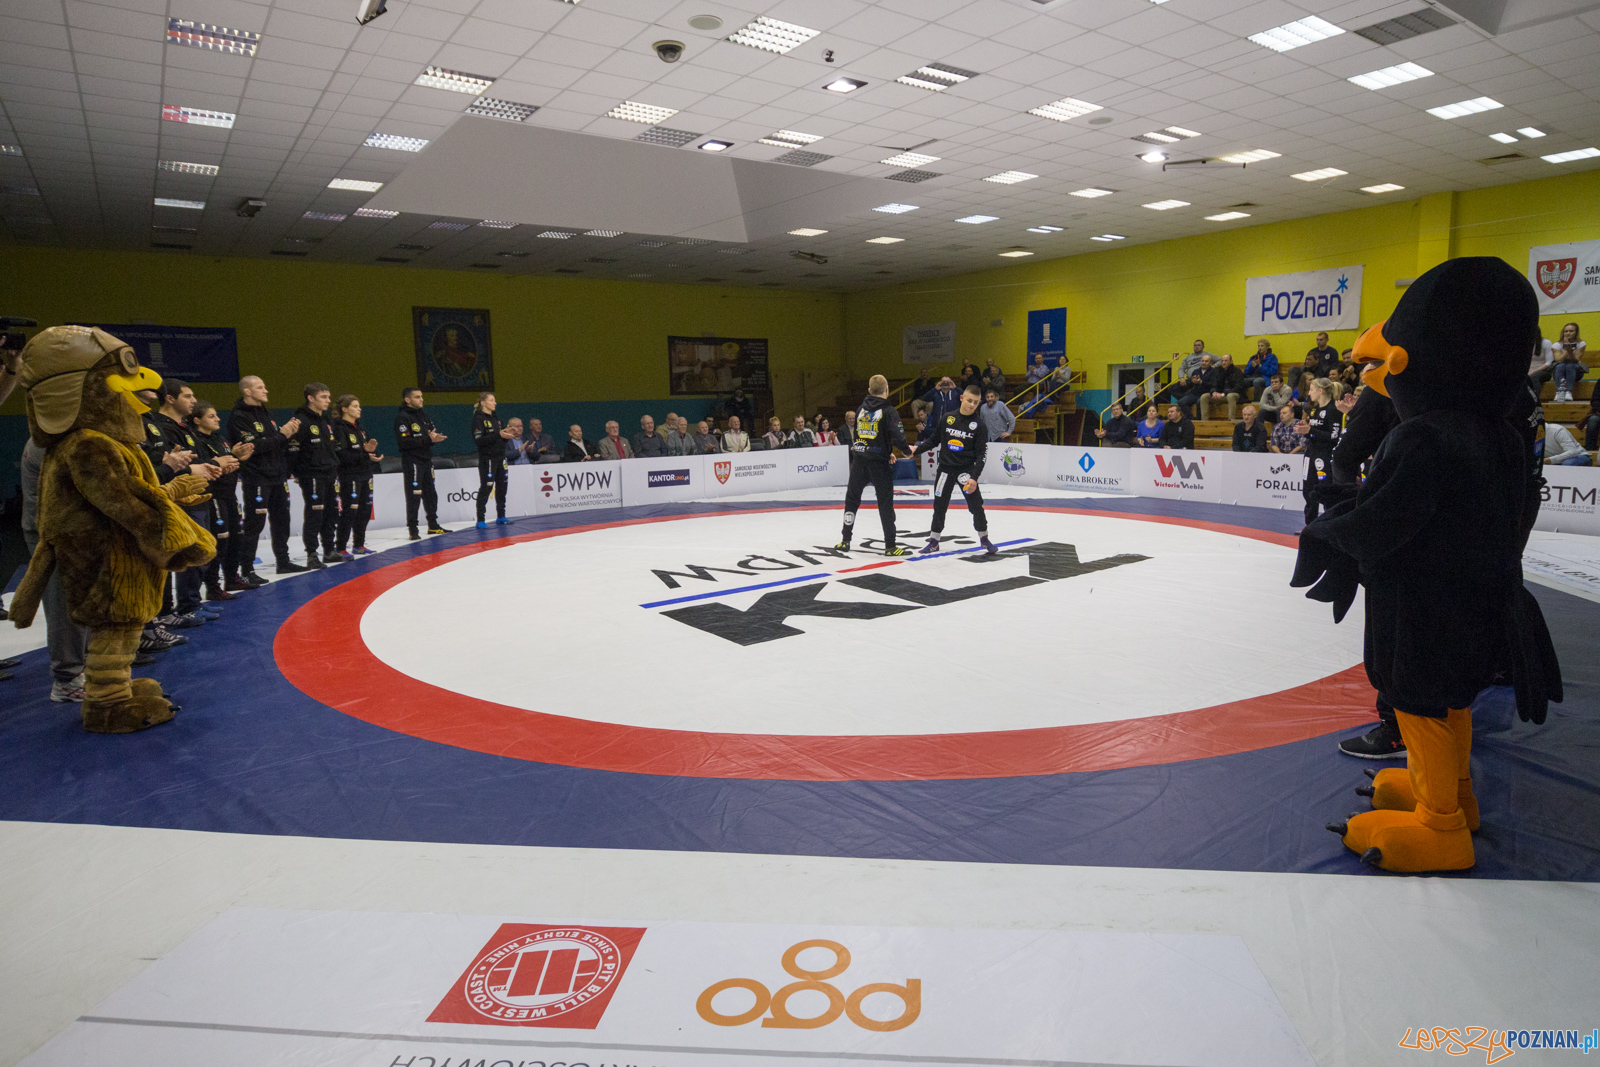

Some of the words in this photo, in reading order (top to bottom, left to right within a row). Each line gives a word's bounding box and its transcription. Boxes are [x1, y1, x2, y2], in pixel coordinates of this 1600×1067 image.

[1584, 276, 1600, 286] WIE
[557, 470, 612, 492] PWPW
[1056, 474, 1080, 483] SUPRA
[1154, 480, 1180, 488] Victoria
[1180, 481, 1204, 490] Meble
[1256, 479, 1303, 491] FORALL
[559, 494, 580, 502] POLSKA
[581, 492, 614, 500] WYTWÓRNIA
[550, 500, 578, 509] PAPIERÓW
[578, 498, 622, 507] WARTOŚCIOWYCH
[525, 931, 580, 944] EIGHTY
[581, 933, 613, 954] SINCE
[486, 941, 520, 964] NINE
[598, 962, 616, 982] PIT
[470, 973, 494, 1010] COAST
[554, 983, 602, 1011] BULL
[492, 1007, 548, 1018] WEST
